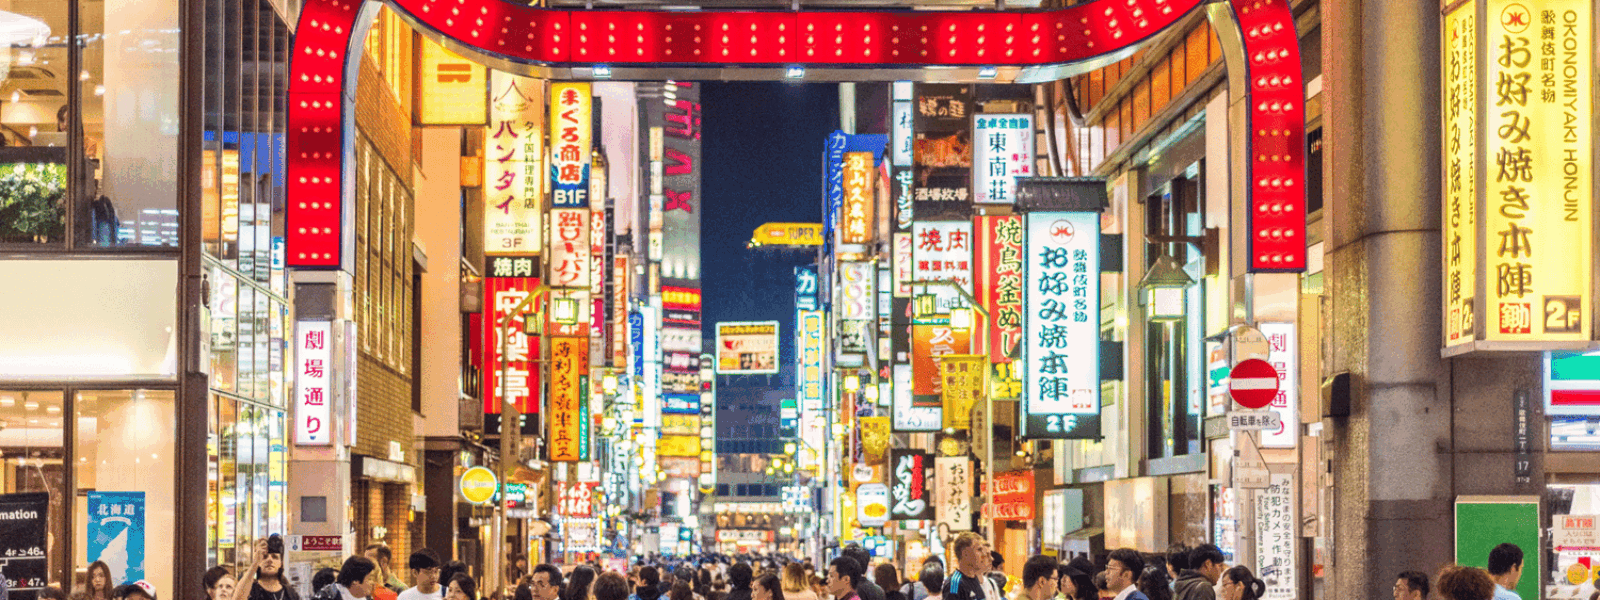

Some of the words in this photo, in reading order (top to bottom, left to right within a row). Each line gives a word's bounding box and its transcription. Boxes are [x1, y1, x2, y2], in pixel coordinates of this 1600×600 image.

[1541, 10, 1556, 103] 歌舞伎町名物
[1563, 10, 1577, 143] OKONOMIYAKI
[493, 120, 518, 214] バンタイ
[560, 89, 580, 182] まぐろ商店
[989, 132, 1006, 200] 東南荘
[1496, 35, 1533, 298] お好み焼き本陣
[553, 189, 587, 204] B1F
[1563, 149, 1577, 222] HONJIN
[494, 257, 532, 277] 焼肉
[502, 237, 522, 248] 3F
[995, 219, 1022, 357] 焼鳥釜めし
[1072, 249, 1087, 322] 歌舞伎町名物
[1545, 300, 1580, 328] 2F
[1038, 246, 1069, 401] お好み焼本陣
[304, 330, 324, 434] 劇場通り
[1046, 414, 1078, 432] 2F
[1231, 415, 1276, 427] 自転車を除く
[1518, 462, 1528, 471] 17
[5, 548, 18, 556] 4F
[1271, 485, 1283, 579] 防犯カメラ作動中
[1282, 478, 1291, 584] みなさまの安全を守ります
[1565, 518, 1594, 528] ATM
